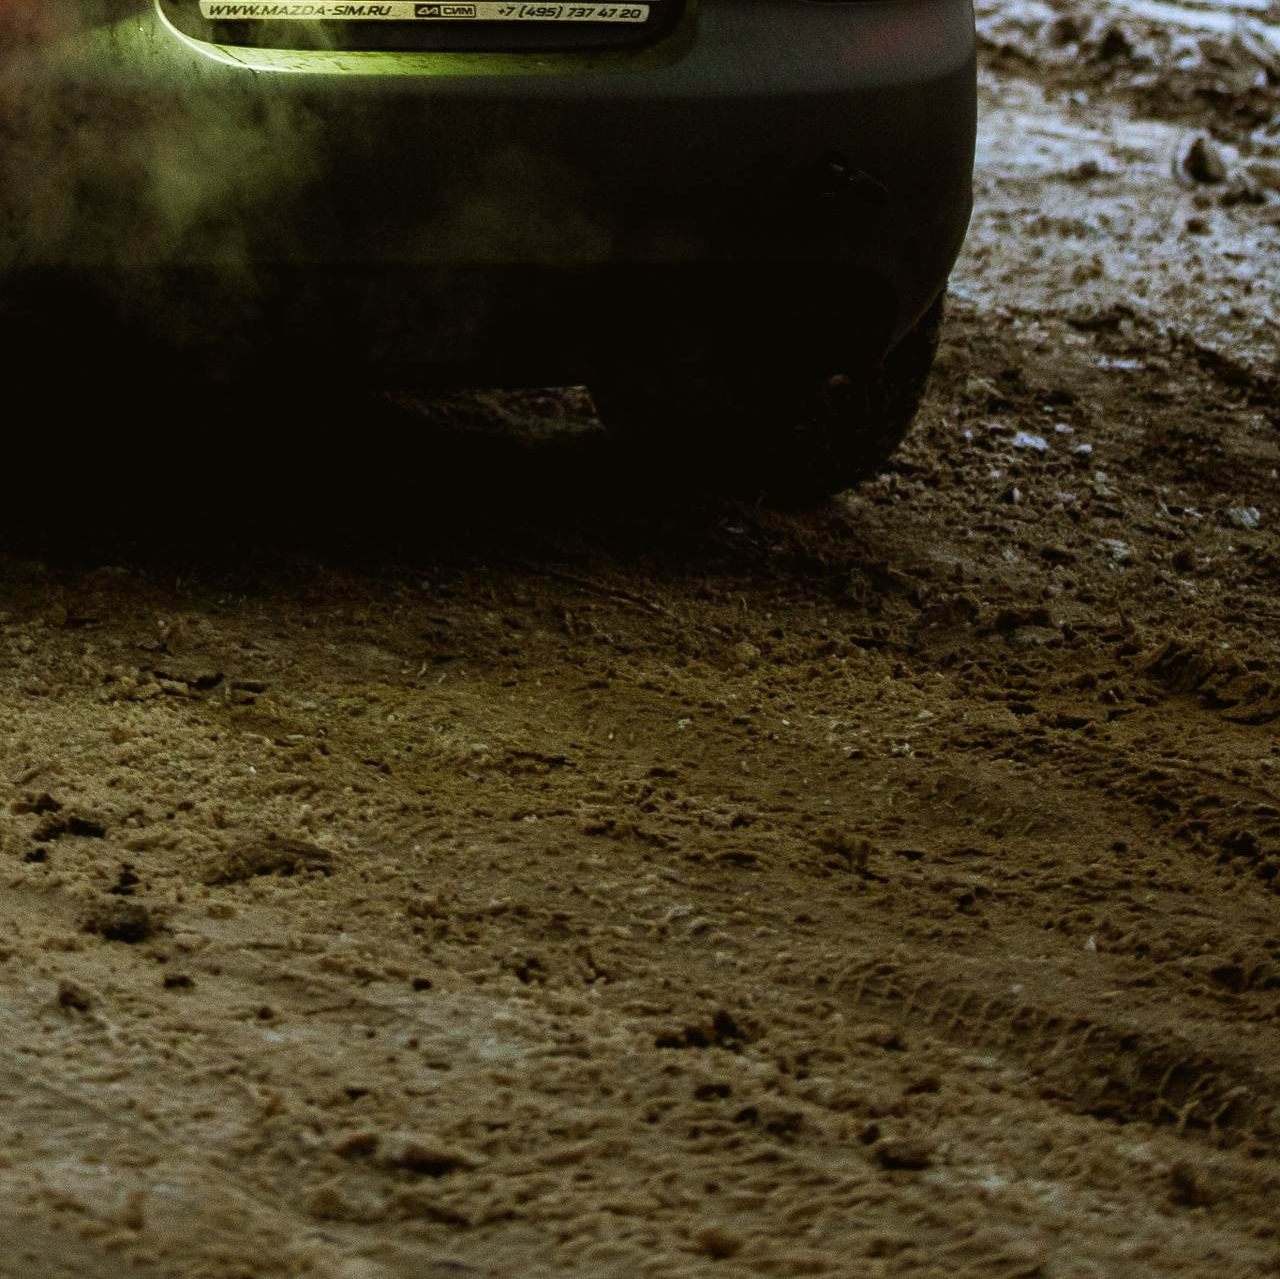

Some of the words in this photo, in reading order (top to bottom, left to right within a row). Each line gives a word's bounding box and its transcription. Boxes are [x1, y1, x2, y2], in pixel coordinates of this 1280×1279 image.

[209, 4, 393, 17] WWW.MAZDA-SIM.RU
[442, 5, 473, 15] СИМ
[498, 7, 515, 17] +7
[518, 5, 563, 19] (495)
[568, 7, 595, 18] 737
[598, 8, 619, 18] 47
[619, 8, 642, 19] 20
